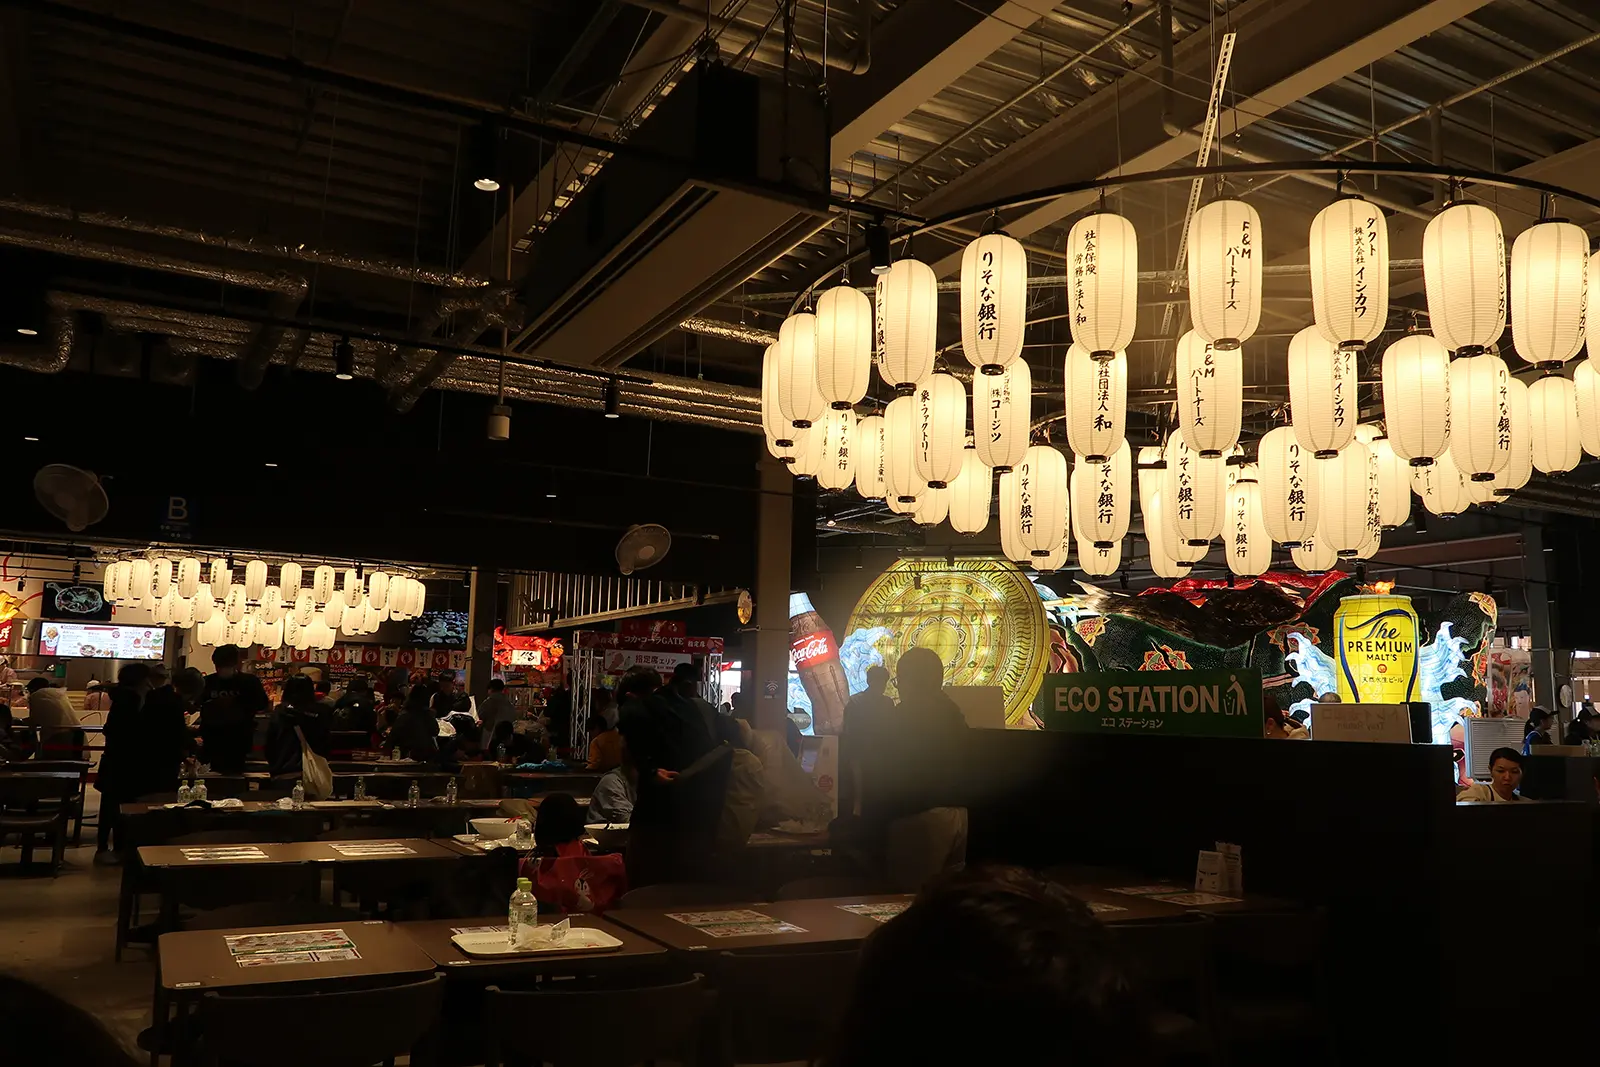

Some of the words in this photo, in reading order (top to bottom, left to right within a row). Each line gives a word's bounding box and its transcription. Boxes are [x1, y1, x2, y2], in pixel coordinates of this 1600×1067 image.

[1084, 230, 1097, 275] 社会保険
[1241, 221, 1251, 259] F&M
[1366, 217, 1377, 256] ダクト
[977, 251, 998, 341] りそな銀行
[1225, 246, 1240, 310] パートナーズ
[1191, 368, 1206, 427] パートナーズ
[1498, 369, 1511, 451] りそな銀行
[838, 413, 849, 471] りそな銀行
[1020, 463, 1033, 534] りそな銀行
[1178, 441, 1194, 520] りそな銀行
[1287, 444, 1306, 521] りそな銀行
[168, 496, 187, 519] B
[1236, 497, 1248, 558] りそな銀行
[1348, 641, 1412, 653] PREMIUM
[1364, 618, 1400, 639] The
[635, 654, 676, 666] 指定席エリア
[1366, 653, 1397, 661] MALT'S
[1055, 687, 1100, 712] ECO
[1108, 685, 1219, 713] STATION
[1101, 718, 1115, 728] エコ
[1119, 718, 1163, 728] ステーション
